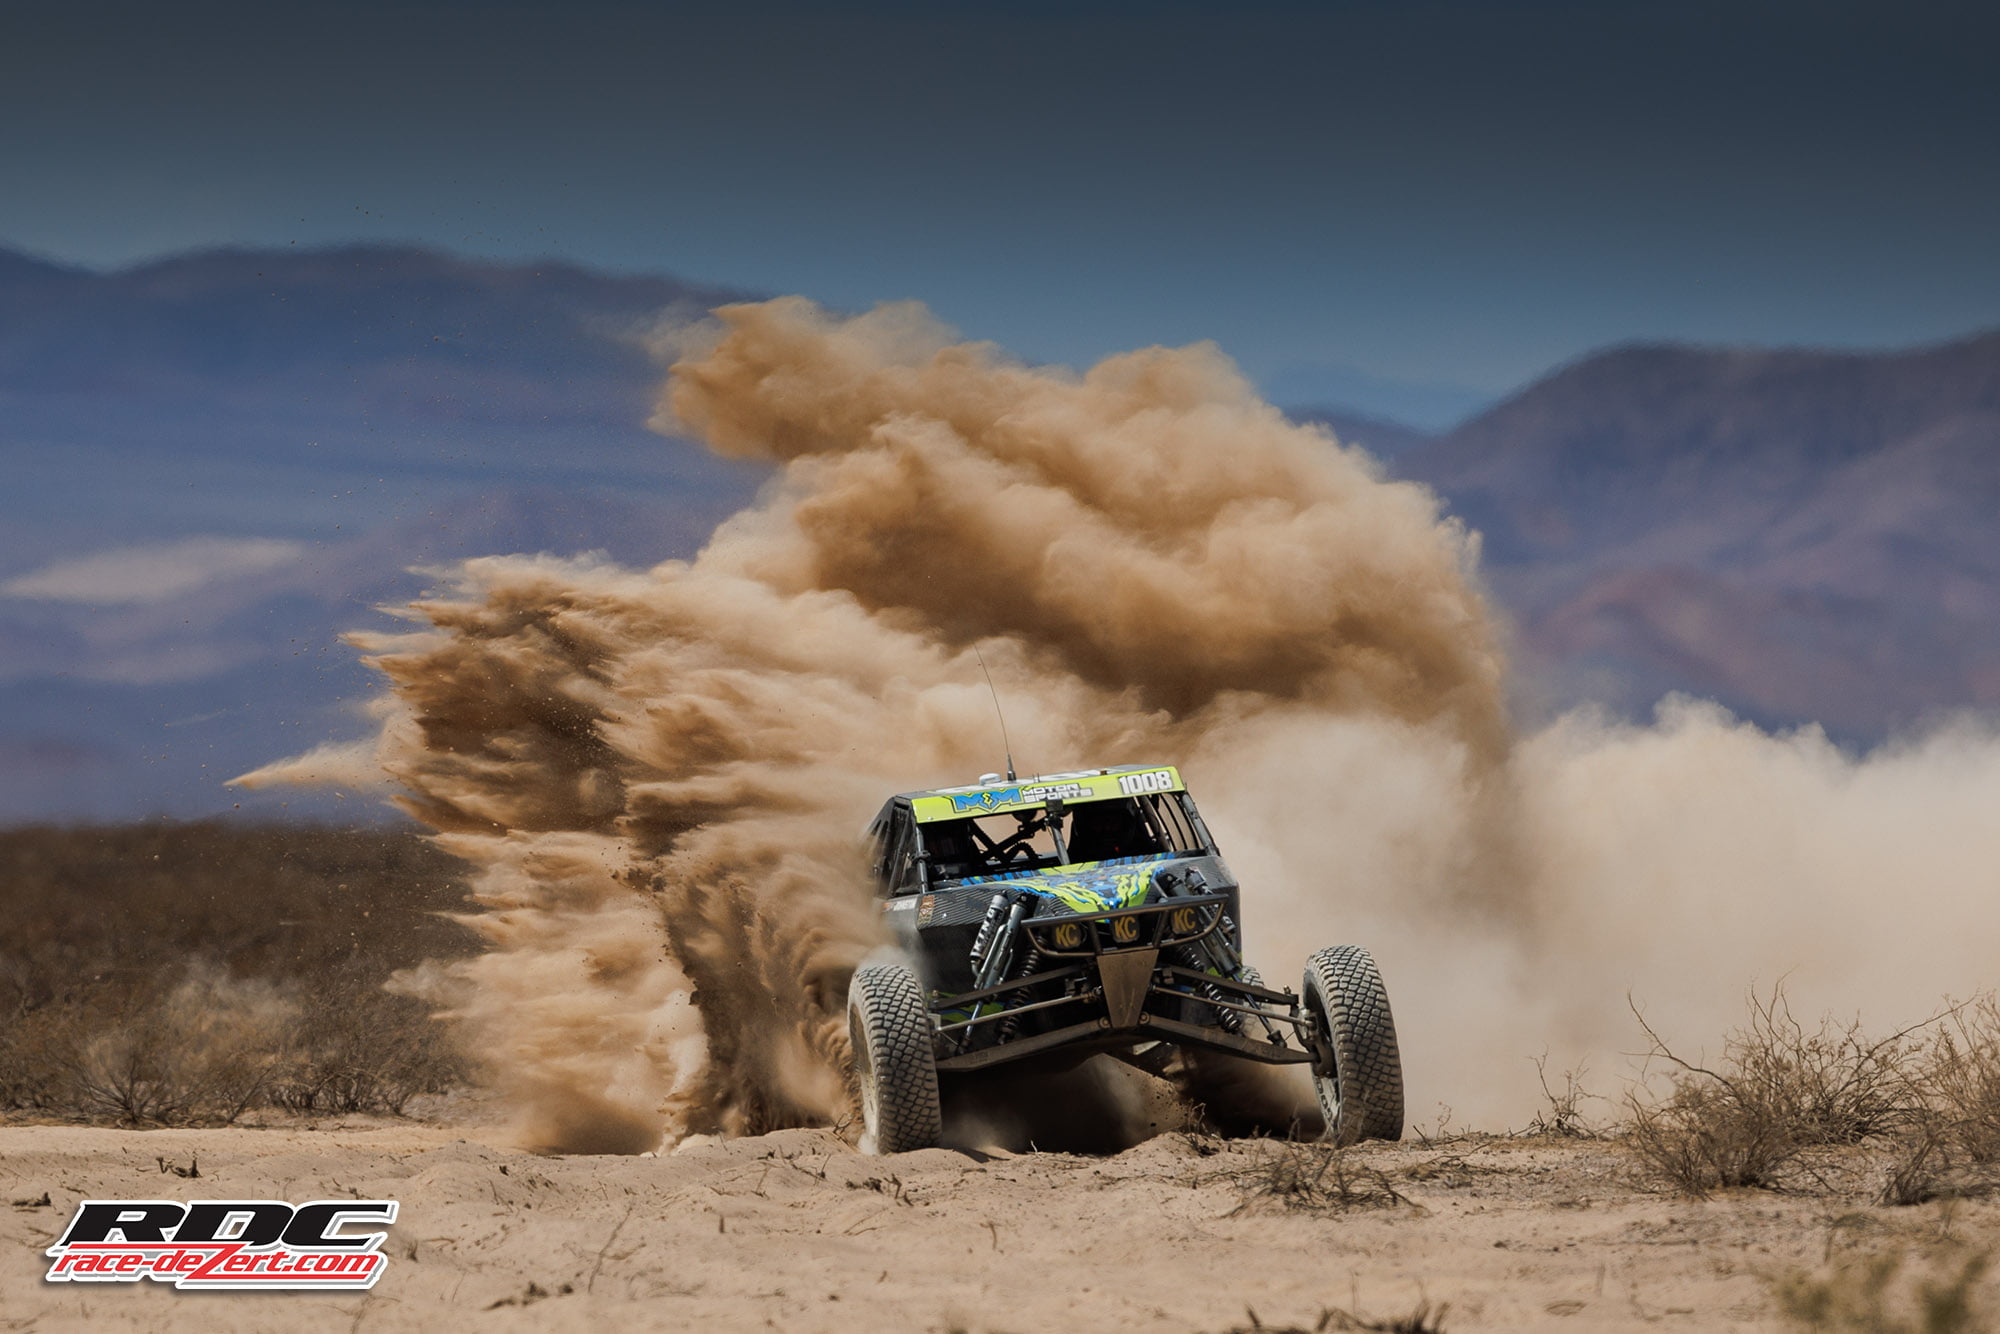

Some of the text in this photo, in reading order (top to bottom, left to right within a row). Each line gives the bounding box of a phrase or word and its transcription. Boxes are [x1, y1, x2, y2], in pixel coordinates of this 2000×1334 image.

[1022, 783, 1080, 797] MOTOR
[1118, 770, 1173, 796] 1008
[1023, 787, 1093, 804] SPORTS
[973, 907, 996, 951] KING
[1114, 916, 1137, 942] KC
[1173, 908, 1197, 932] KC
[1055, 923, 1077, 947] KC
